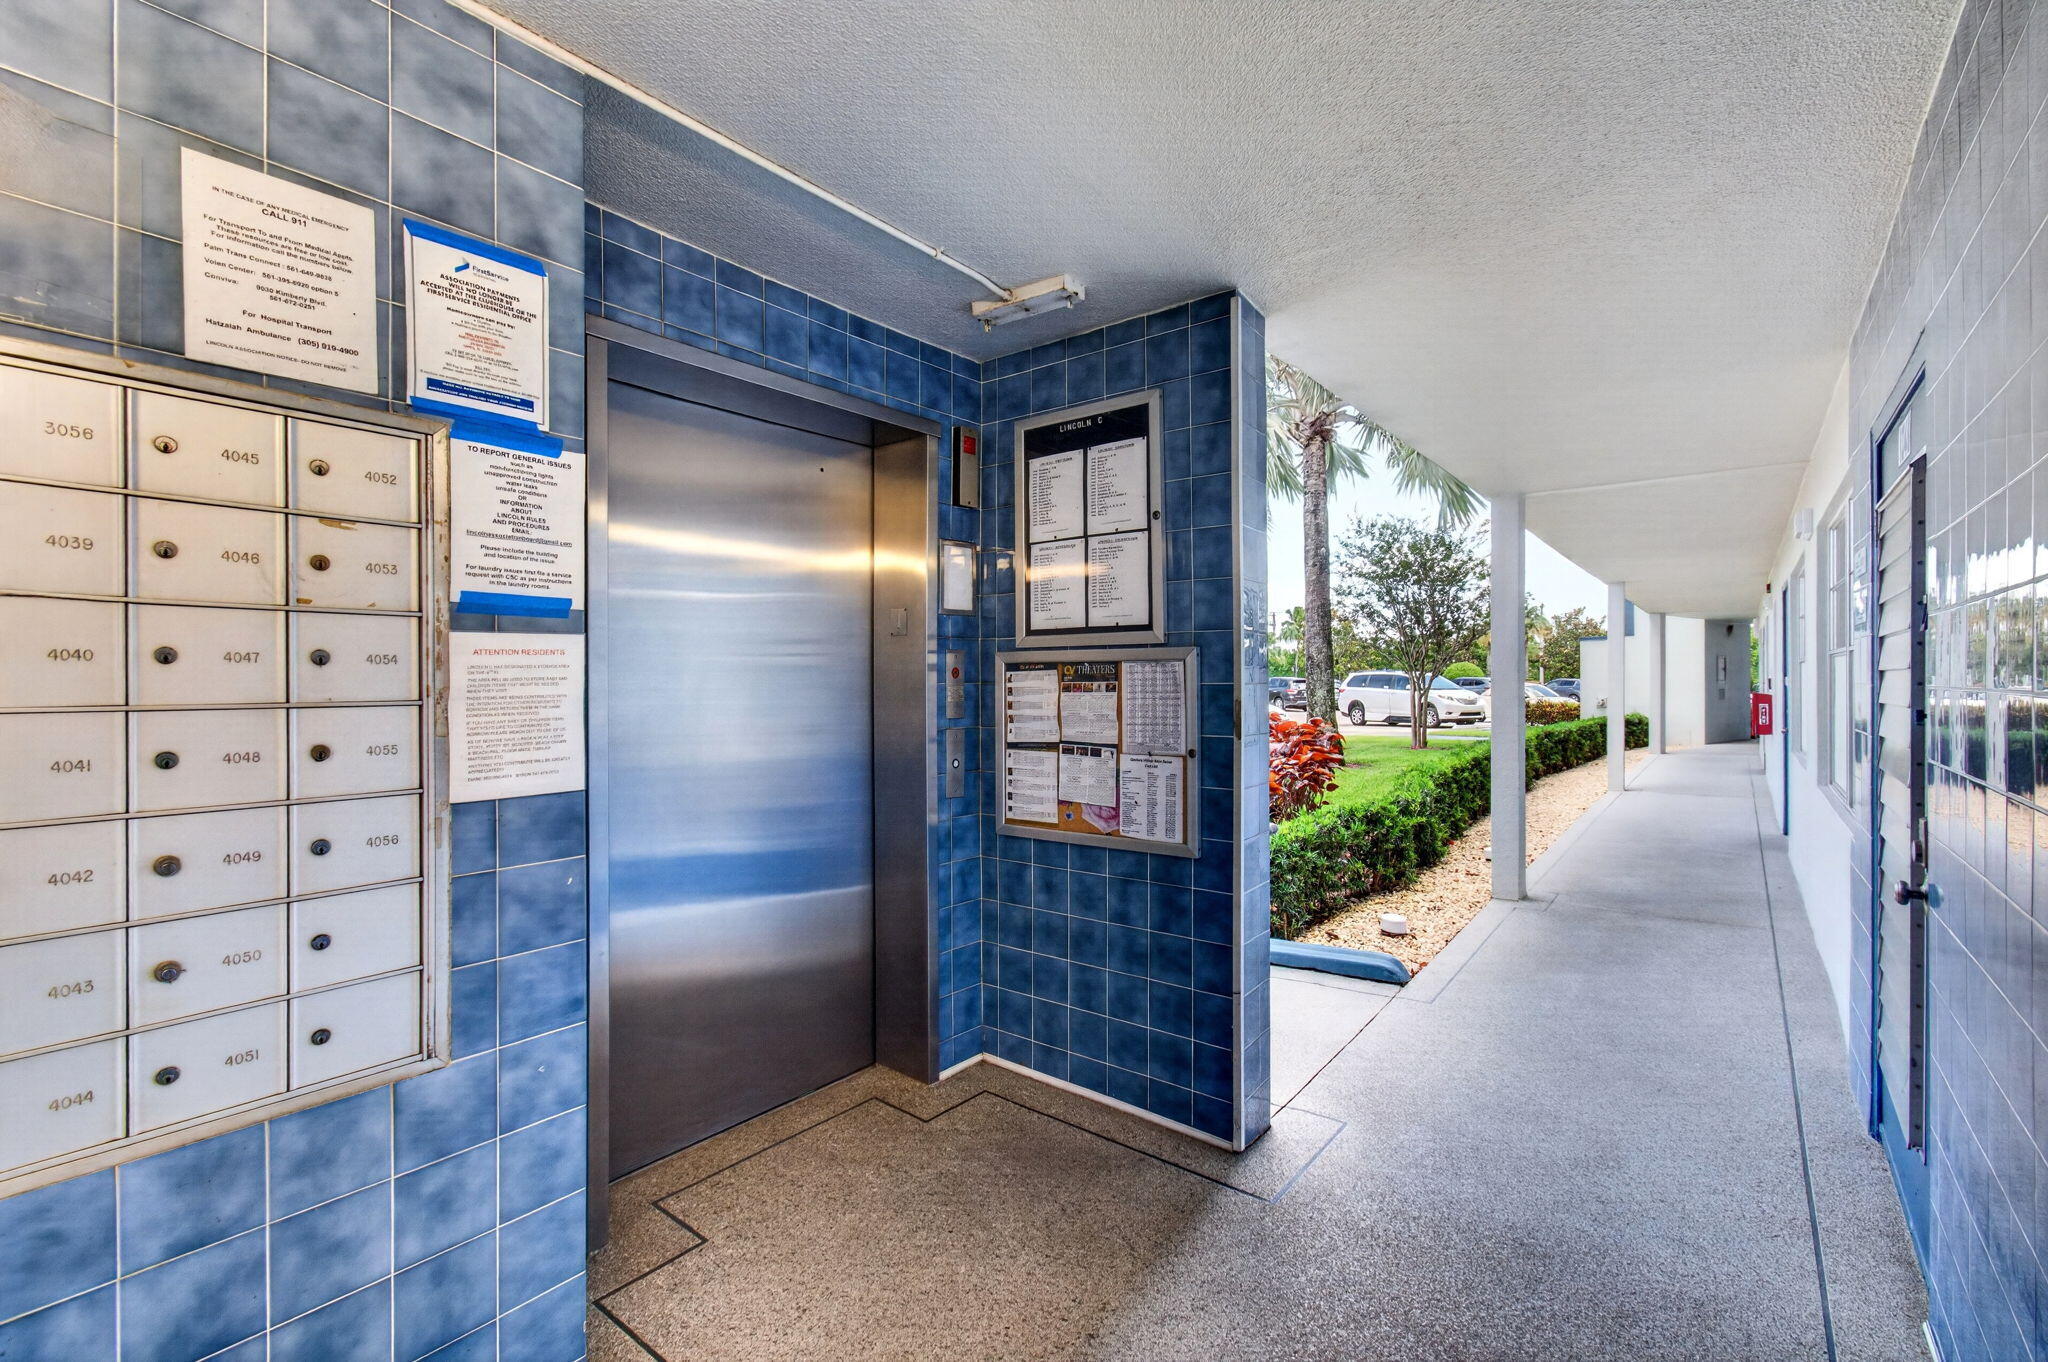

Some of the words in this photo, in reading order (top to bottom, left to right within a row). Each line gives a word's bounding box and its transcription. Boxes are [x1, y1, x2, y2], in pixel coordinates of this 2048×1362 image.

[222, 189, 234, 197] THE
[237, 194, 253, 203] CASE
[267, 203, 280, 211] ANY
[282, 208, 310, 220] MEDICAL
[312, 217, 349, 232] EMERGENCY
[262, 208, 288, 222] CALL
[292, 217, 307, 228] 911
[204, 214, 216, 223] For
[219, 218, 256, 235] Transport
[258, 230, 266, 238] To
[269, 233, 282, 242] and
[284, 237, 302, 248] From
[305, 243, 331, 256] Medical
[211, 230, 224, 239] For
[227, 235, 269, 252] information
[272, 247, 284, 256] call
[300, 255, 330, 268] numbers
[217, 225, 239, 236] These
[242, 232, 278, 247] resources
[281, 243, 291, 251] are
[294, 247, 307, 255] free
[319, 254, 330, 262] low
[205, 243, 223, 253] Palm
[227, 249, 246, 259] Trans
[250, 255, 281, 268] Connect
[473, 265, 509, 283] FirstService
[276, 290, 307, 302] Kimberly
[311, 286, 332, 295] option
[440, 273, 486, 292] ASSOCIATION
[488, 288, 520, 303] PAYMENTS
[449, 282, 464, 291] WILL
[466, 287, 477, 295] NO
[479, 291, 504, 304] LONGER
[420, 279, 453, 294] ACCEPTED
[466, 293, 477, 301] THE
[479, 297, 514, 313] CLUBHOUSE
[527, 312, 537, 320] THE
[243, 310, 256, 319] For
[261, 314, 293, 327] Hospital
[296, 322, 332, 336] Transport
[247, 327, 292, 342] Ambulance
[298, 338, 320, 348] (305)
[44, 422, 94, 440] 3056
[1060, 419, 1091, 433] LINCOLN
[1098, 416, 1102, 424] C
[221, 449, 260, 465] 4045
[481, 448, 510, 458] REPORT
[512, 454, 545, 465] GENERAL
[547, 460, 572, 470] ISSUES
[364, 471, 397, 485] 4052
[484, 470, 520, 480] unapproved
[522, 477, 558, 486] construction
[518, 489, 547, 498] conditions
[500, 499, 542, 510] INFORMATION
[497, 513, 525, 521] LINCOLN
[527, 516, 546, 524] RULES
[508, 520, 550, 531] PROCEDURES
[45, 535, 94, 551] 4039
[221, 550, 260, 565] 4046
[536, 551, 558, 559] building
[365, 562, 398, 575] 4053
[479, 565, 502, 573] laundry
[47, 648, 94, 662] 4040
[223, 652, 260, 664] 4047
[366, 654, 398, 665] 4054
[1077, 664, 1115, 674] THEATERS
[222, 752, 261, 764] 4048
[366, 745, 398, 757] 4055
[50, 760, 91, 774] 4041
[366, 834, 399, 848] 4056
[222, 850, 262, 865] 4049
[47, 869, 94, 887] 4042
[222, 950, 262, 966] 4050
[48, 981, 94, 1000] 4043
[224, 1050, 259, 1066] 4051
[48, 1090, 94, 1112] 4044
